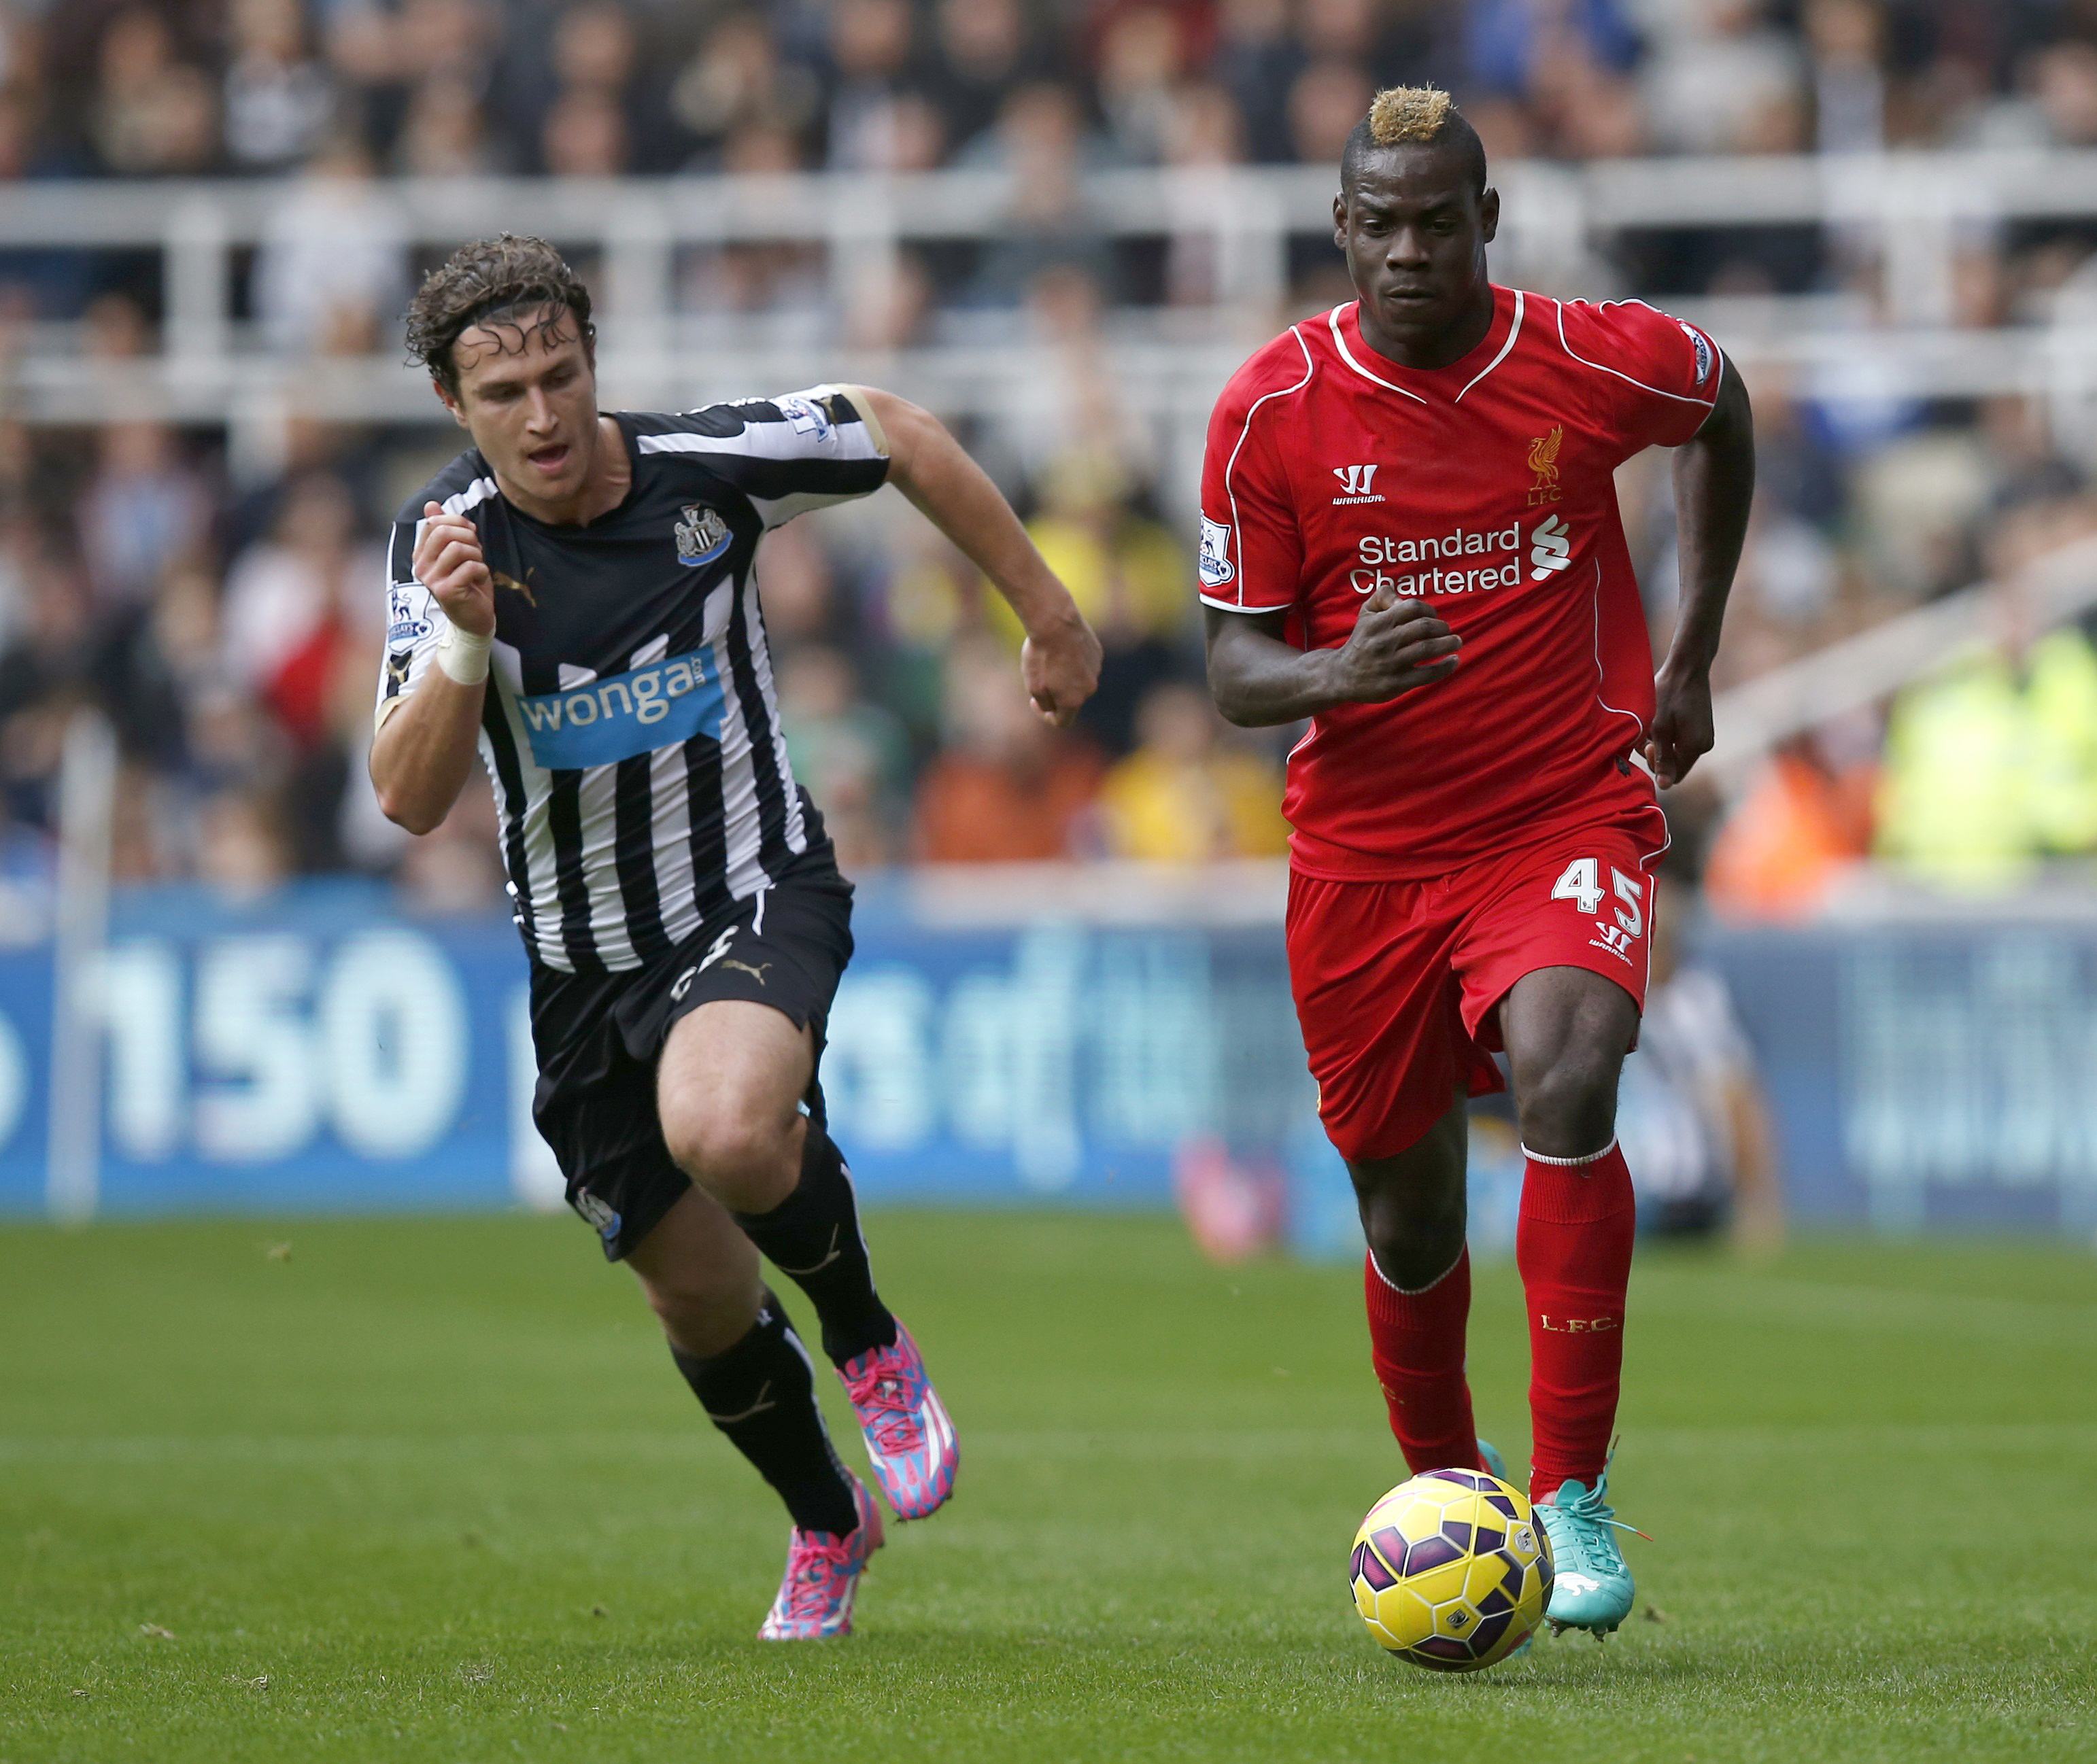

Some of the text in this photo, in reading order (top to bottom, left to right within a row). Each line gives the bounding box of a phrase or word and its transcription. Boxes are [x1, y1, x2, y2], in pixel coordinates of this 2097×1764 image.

[1332, 494, 1383, 505] WARRIOR
[1359, 521, 1520, 565] Standard
[1349, 556, 1520, 596] Chartered
[519, 661, 695, 731] wonga
[1550, 857, 1643, 939] 45
[87, 930, 468, 1161] 150
